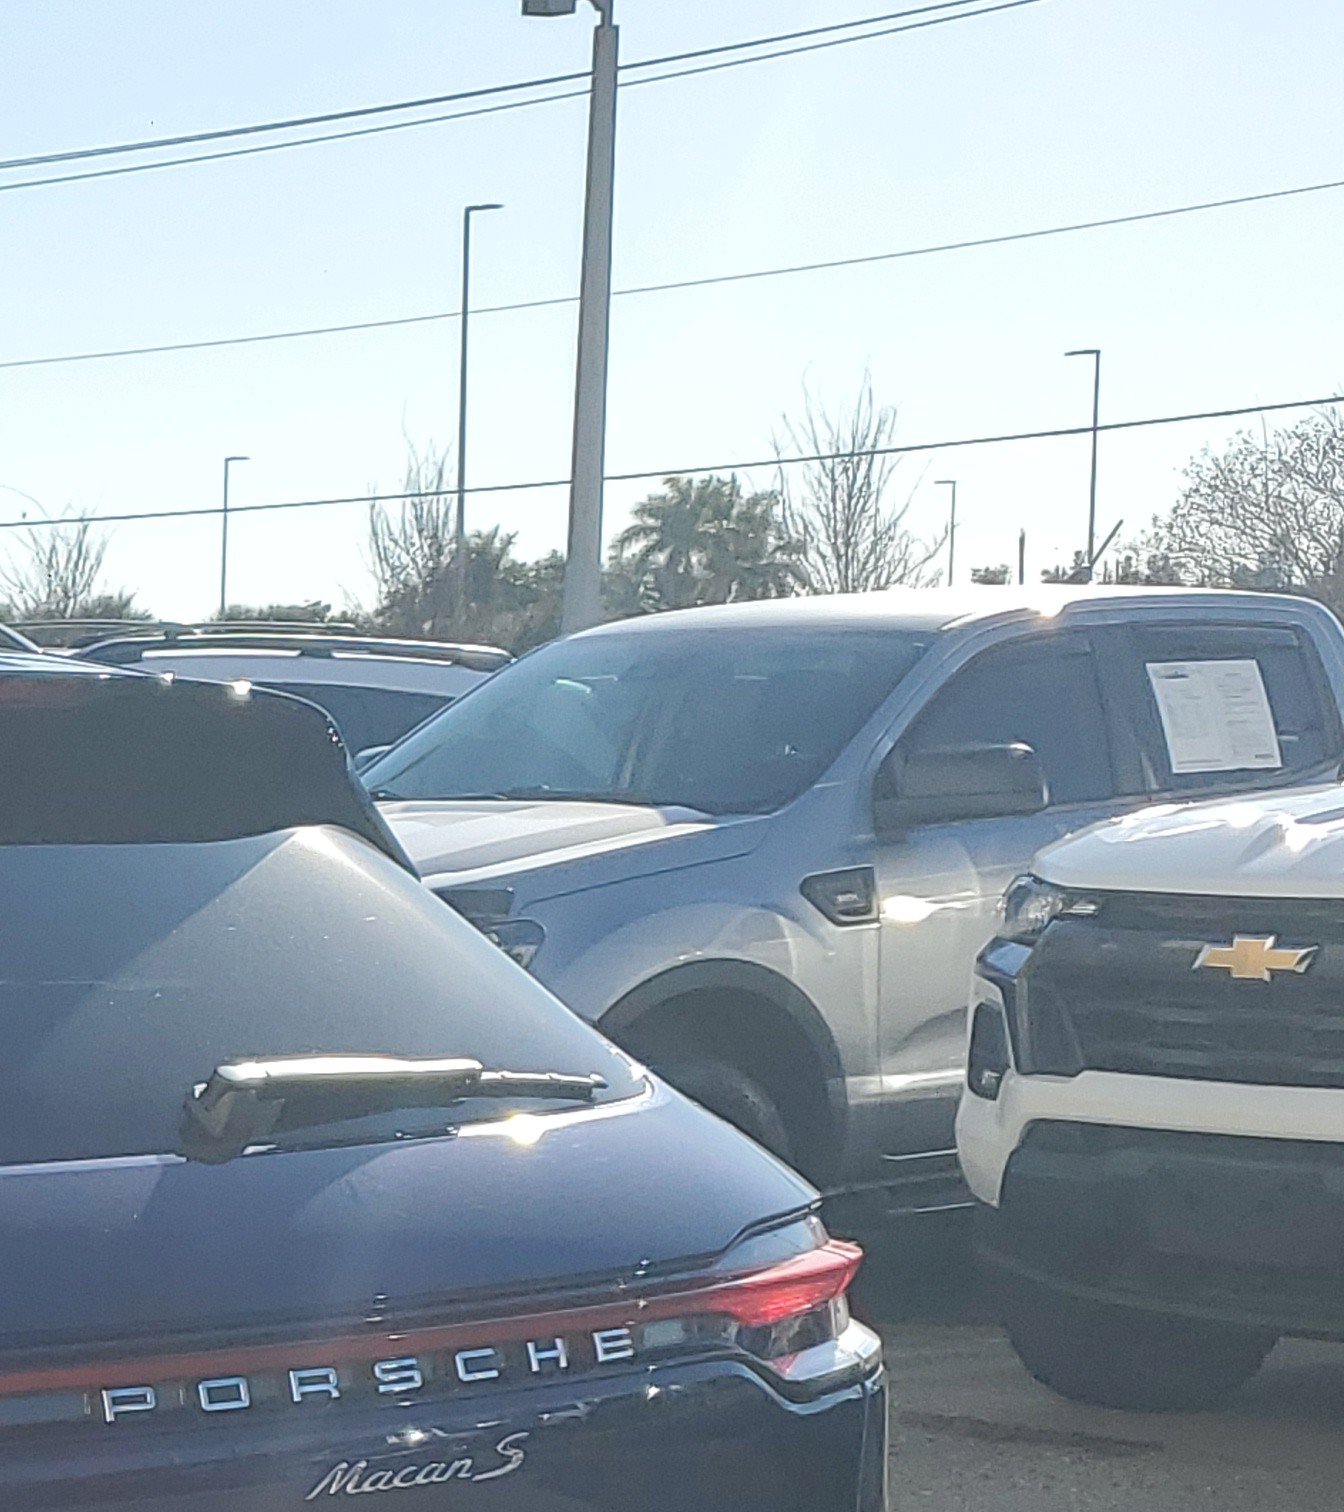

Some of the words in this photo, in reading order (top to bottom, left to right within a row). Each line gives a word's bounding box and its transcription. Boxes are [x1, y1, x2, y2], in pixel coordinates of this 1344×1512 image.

[101, 1327, 634, 1423] PORSCHE
[305, 1457, 473, 1500] Macan
[471, 1431, 530, 1482] S
